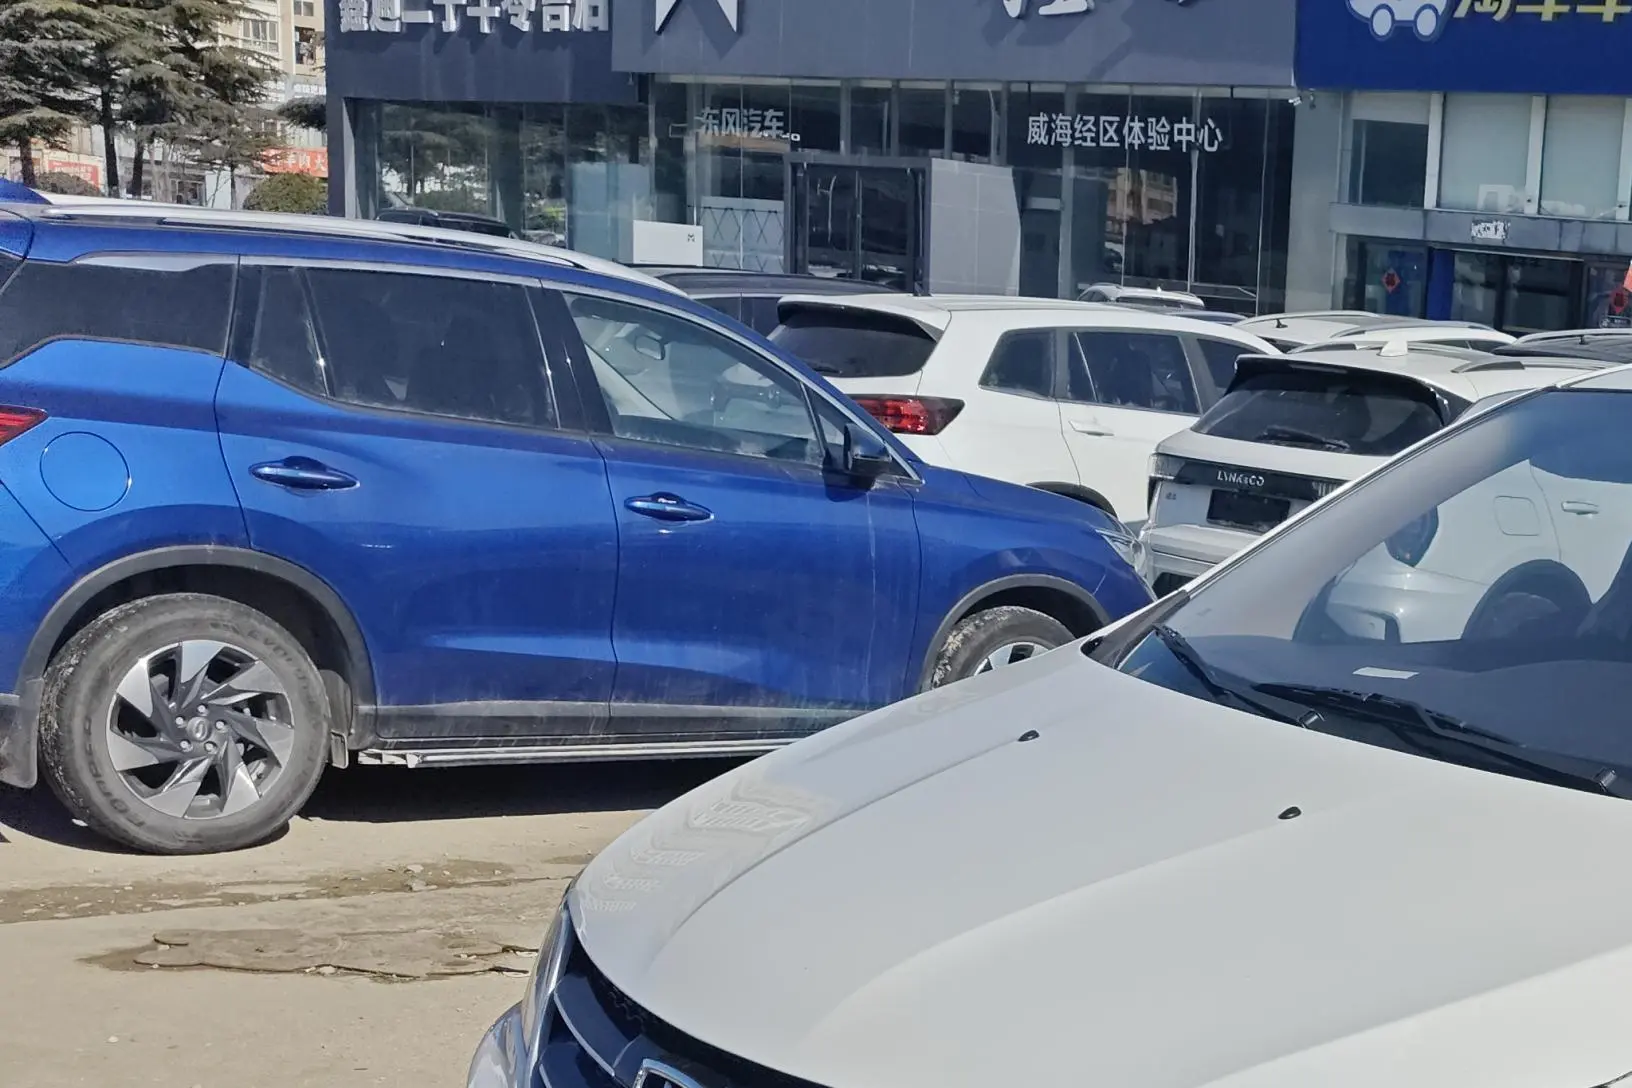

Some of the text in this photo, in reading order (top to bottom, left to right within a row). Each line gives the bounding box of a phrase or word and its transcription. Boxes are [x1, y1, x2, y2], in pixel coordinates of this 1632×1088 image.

[700, 107, 785, 138] 东风汽车
[1027, 112, 1223, 152] 威海经区体验中心
